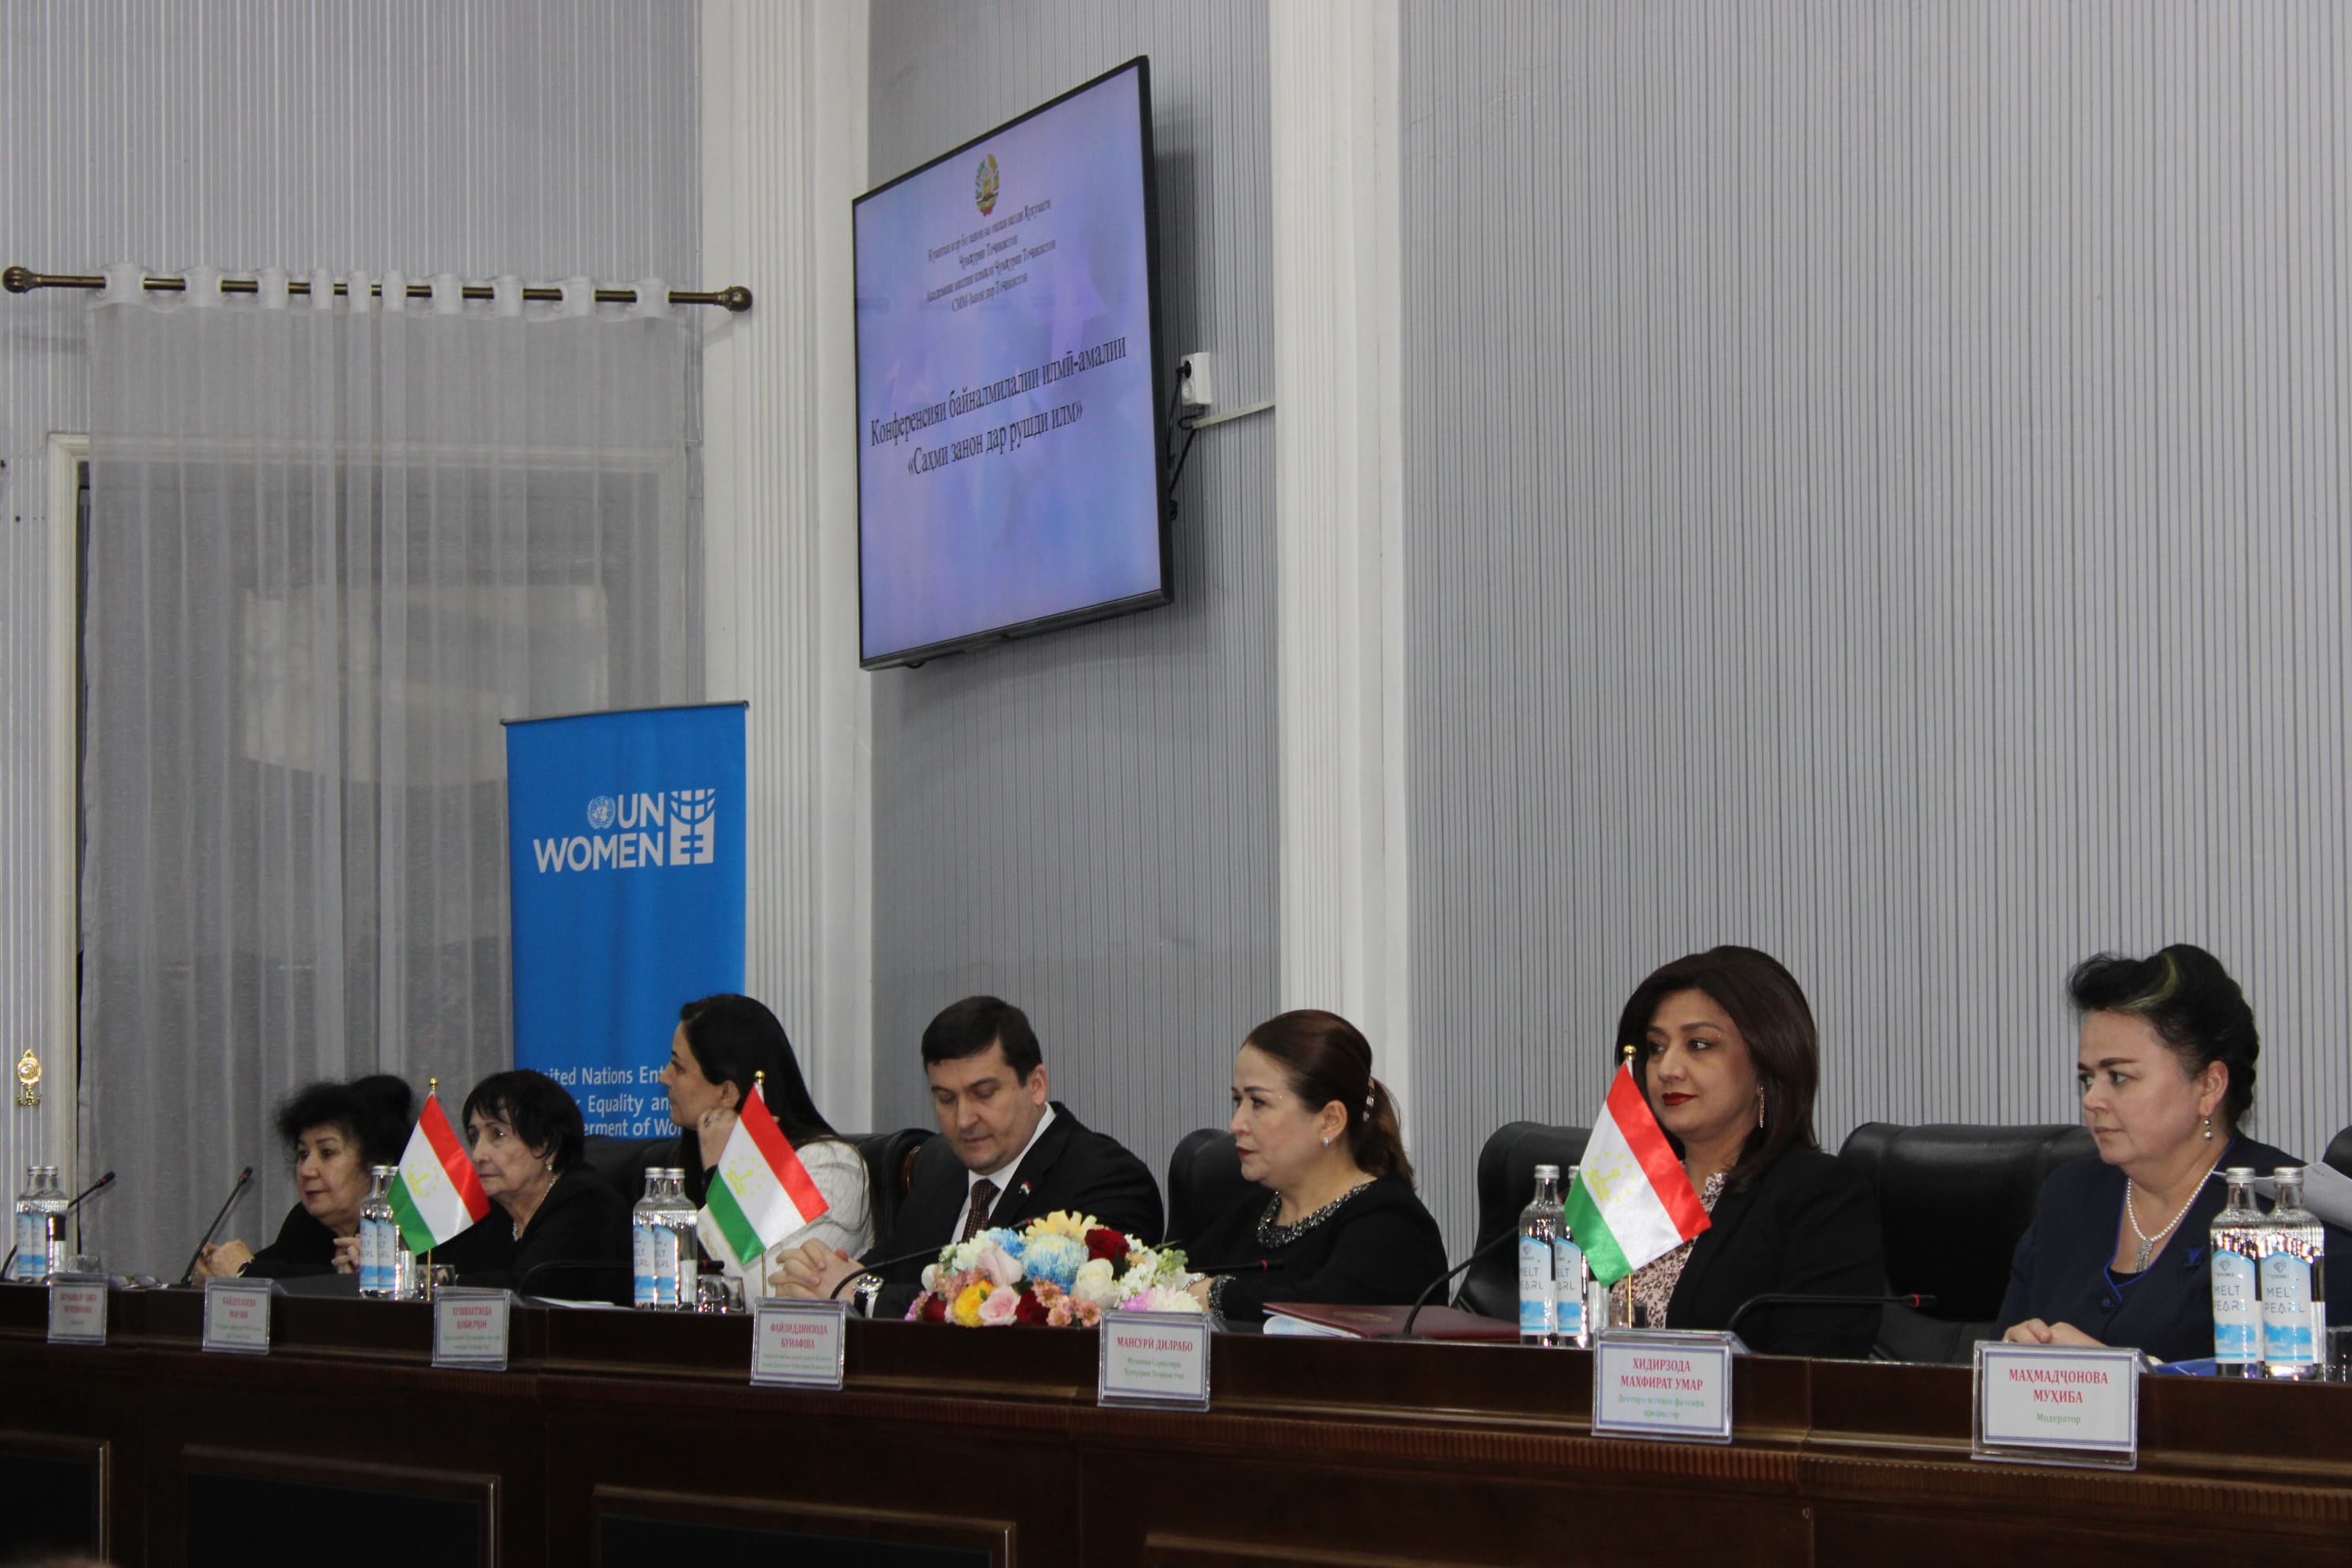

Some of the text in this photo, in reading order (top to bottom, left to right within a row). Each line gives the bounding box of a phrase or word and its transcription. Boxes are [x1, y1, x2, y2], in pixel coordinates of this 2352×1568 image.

[871, 401, 947, 447] Конференсияи
[949, 368, 1039, 417] байналмилалии
[951, 434, 983, 462] занон
[986, 427, 1007, 455] дар
[1009, 412, 1049, 451] рушди
[1052, 401, 1083, 429] илм»
[618, 792, 665, 828] UN
[533, 831, 663, 873] WOMEN
[537, 1067, 576, 1086] ited
[582, 1065, 633, 1085] Nations
[588, 1093, 673, 1118] Equality an
[632, 1117, 651, 1136] of
[2214, 1300, 2248, 1312] EARL
[1155, 1340, 1193, 1352] ДИЛРАБО
[1633, 1357, 1691, 1374] ХИДИРЗОДА
[1621, 1375, 1703, 1391] МАХФИРАТ УМАР
[2034, 1389, 2082, 1404] МУҲИБА
[2037, 1413, 2081, 1426] Модератор
